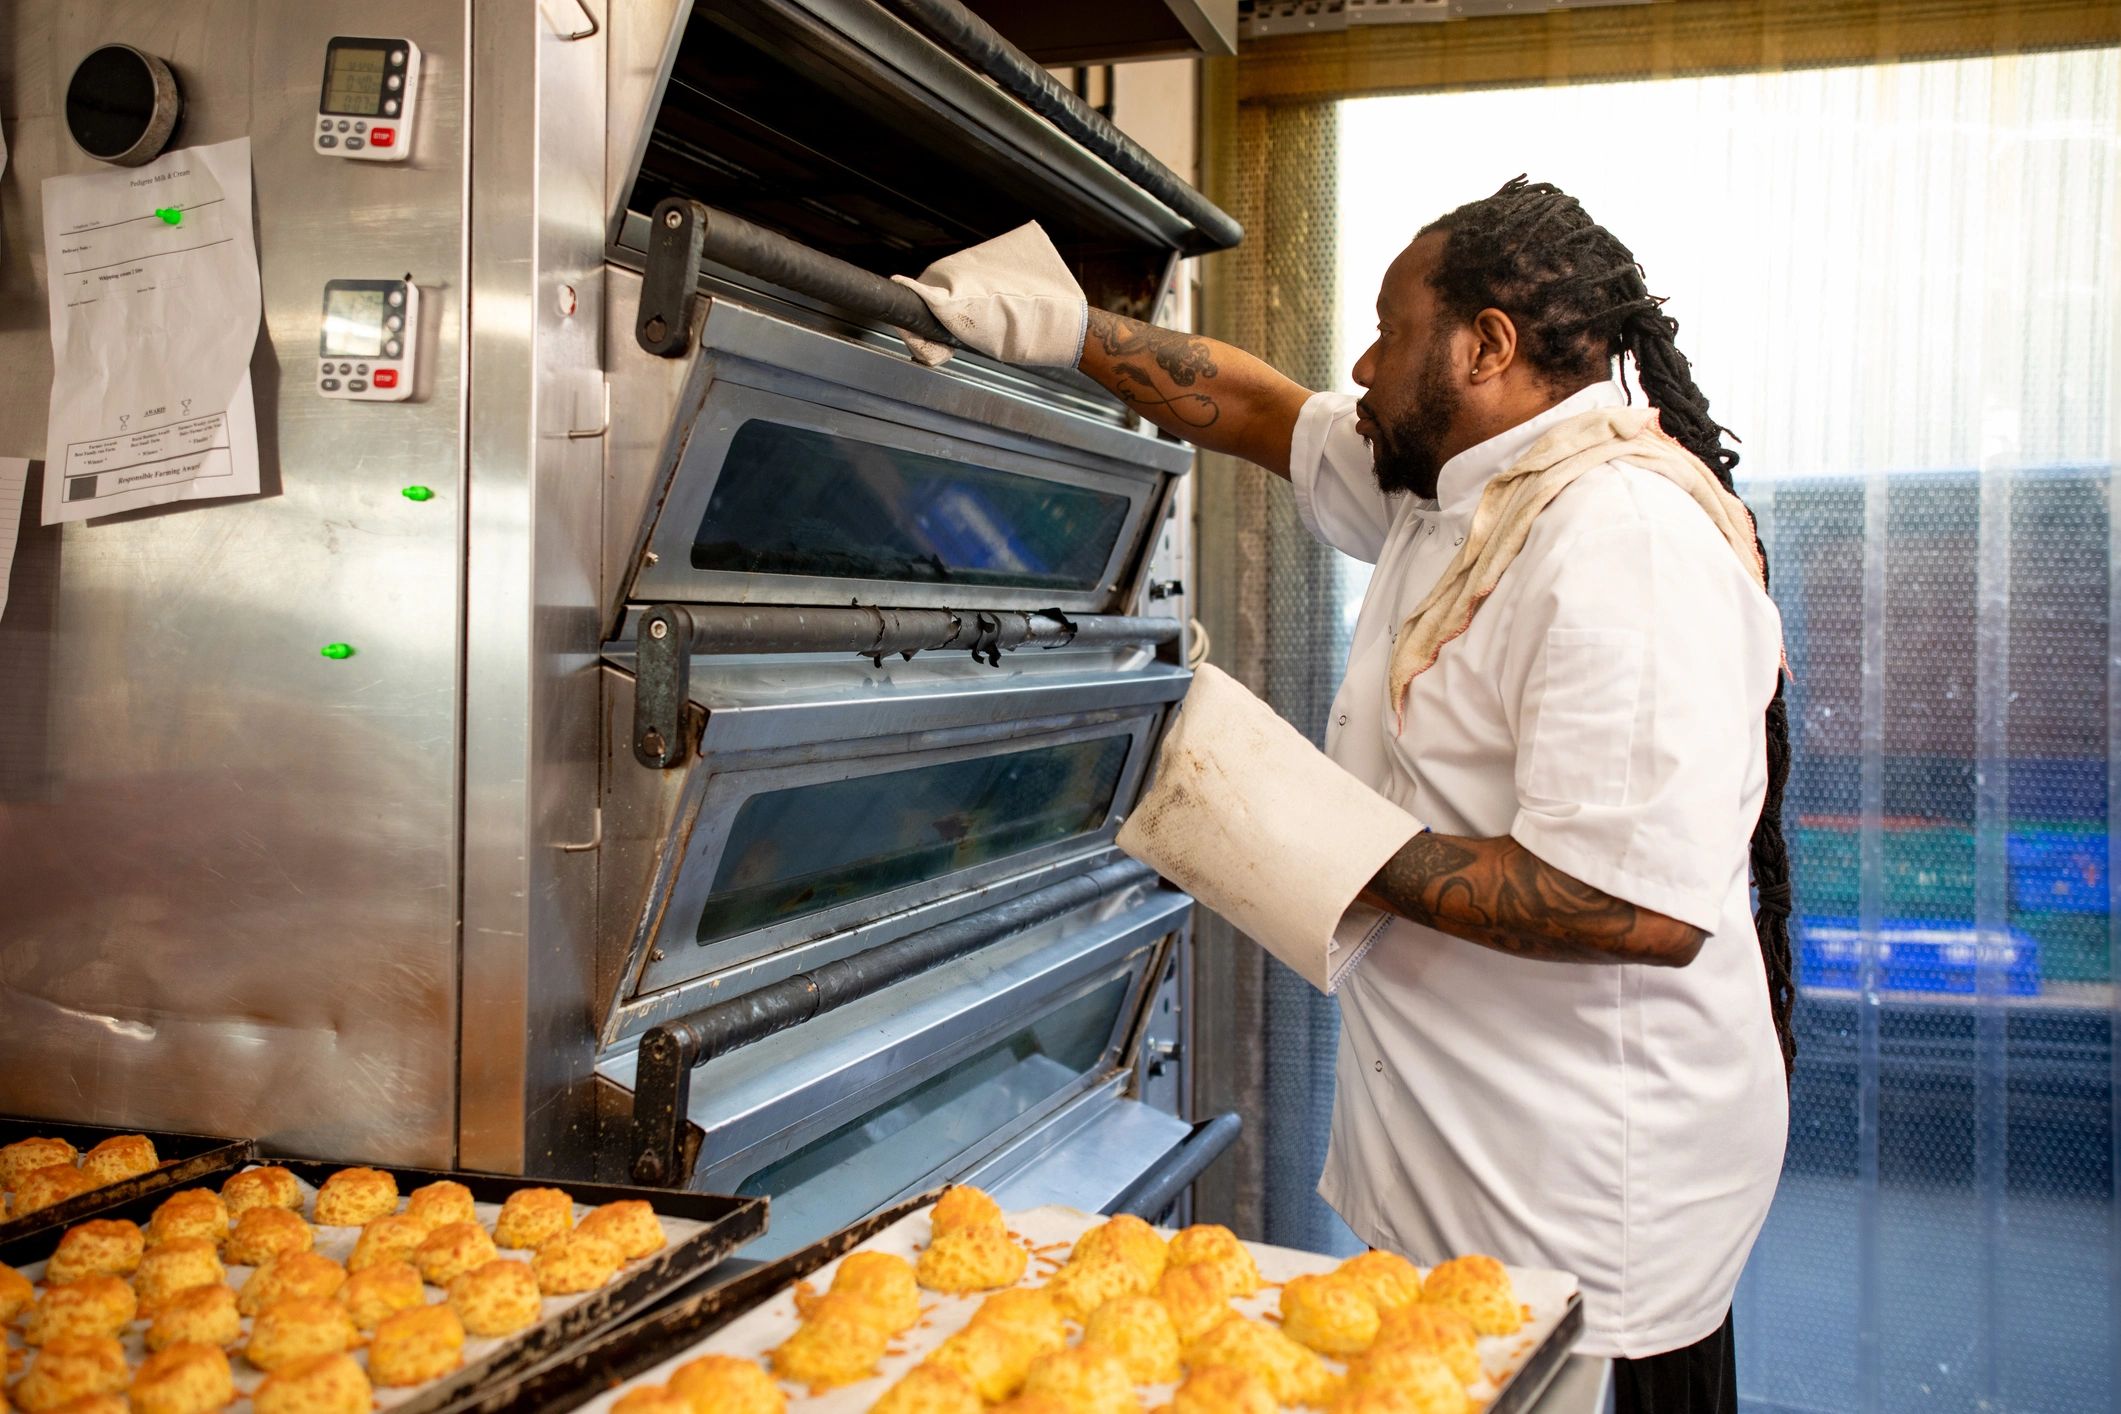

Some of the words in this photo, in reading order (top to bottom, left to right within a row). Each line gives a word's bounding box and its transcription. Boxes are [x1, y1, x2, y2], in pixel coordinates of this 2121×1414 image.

[373, 132, 390, 140] STOP
[130, 177, 153, 188] Pedigree
[154, 174, 167, 183] Milk
[173, 169, 191, 178] Cream
[118, 472, 153, 484] Responsible
[154, 468, 180, 478] Farming
